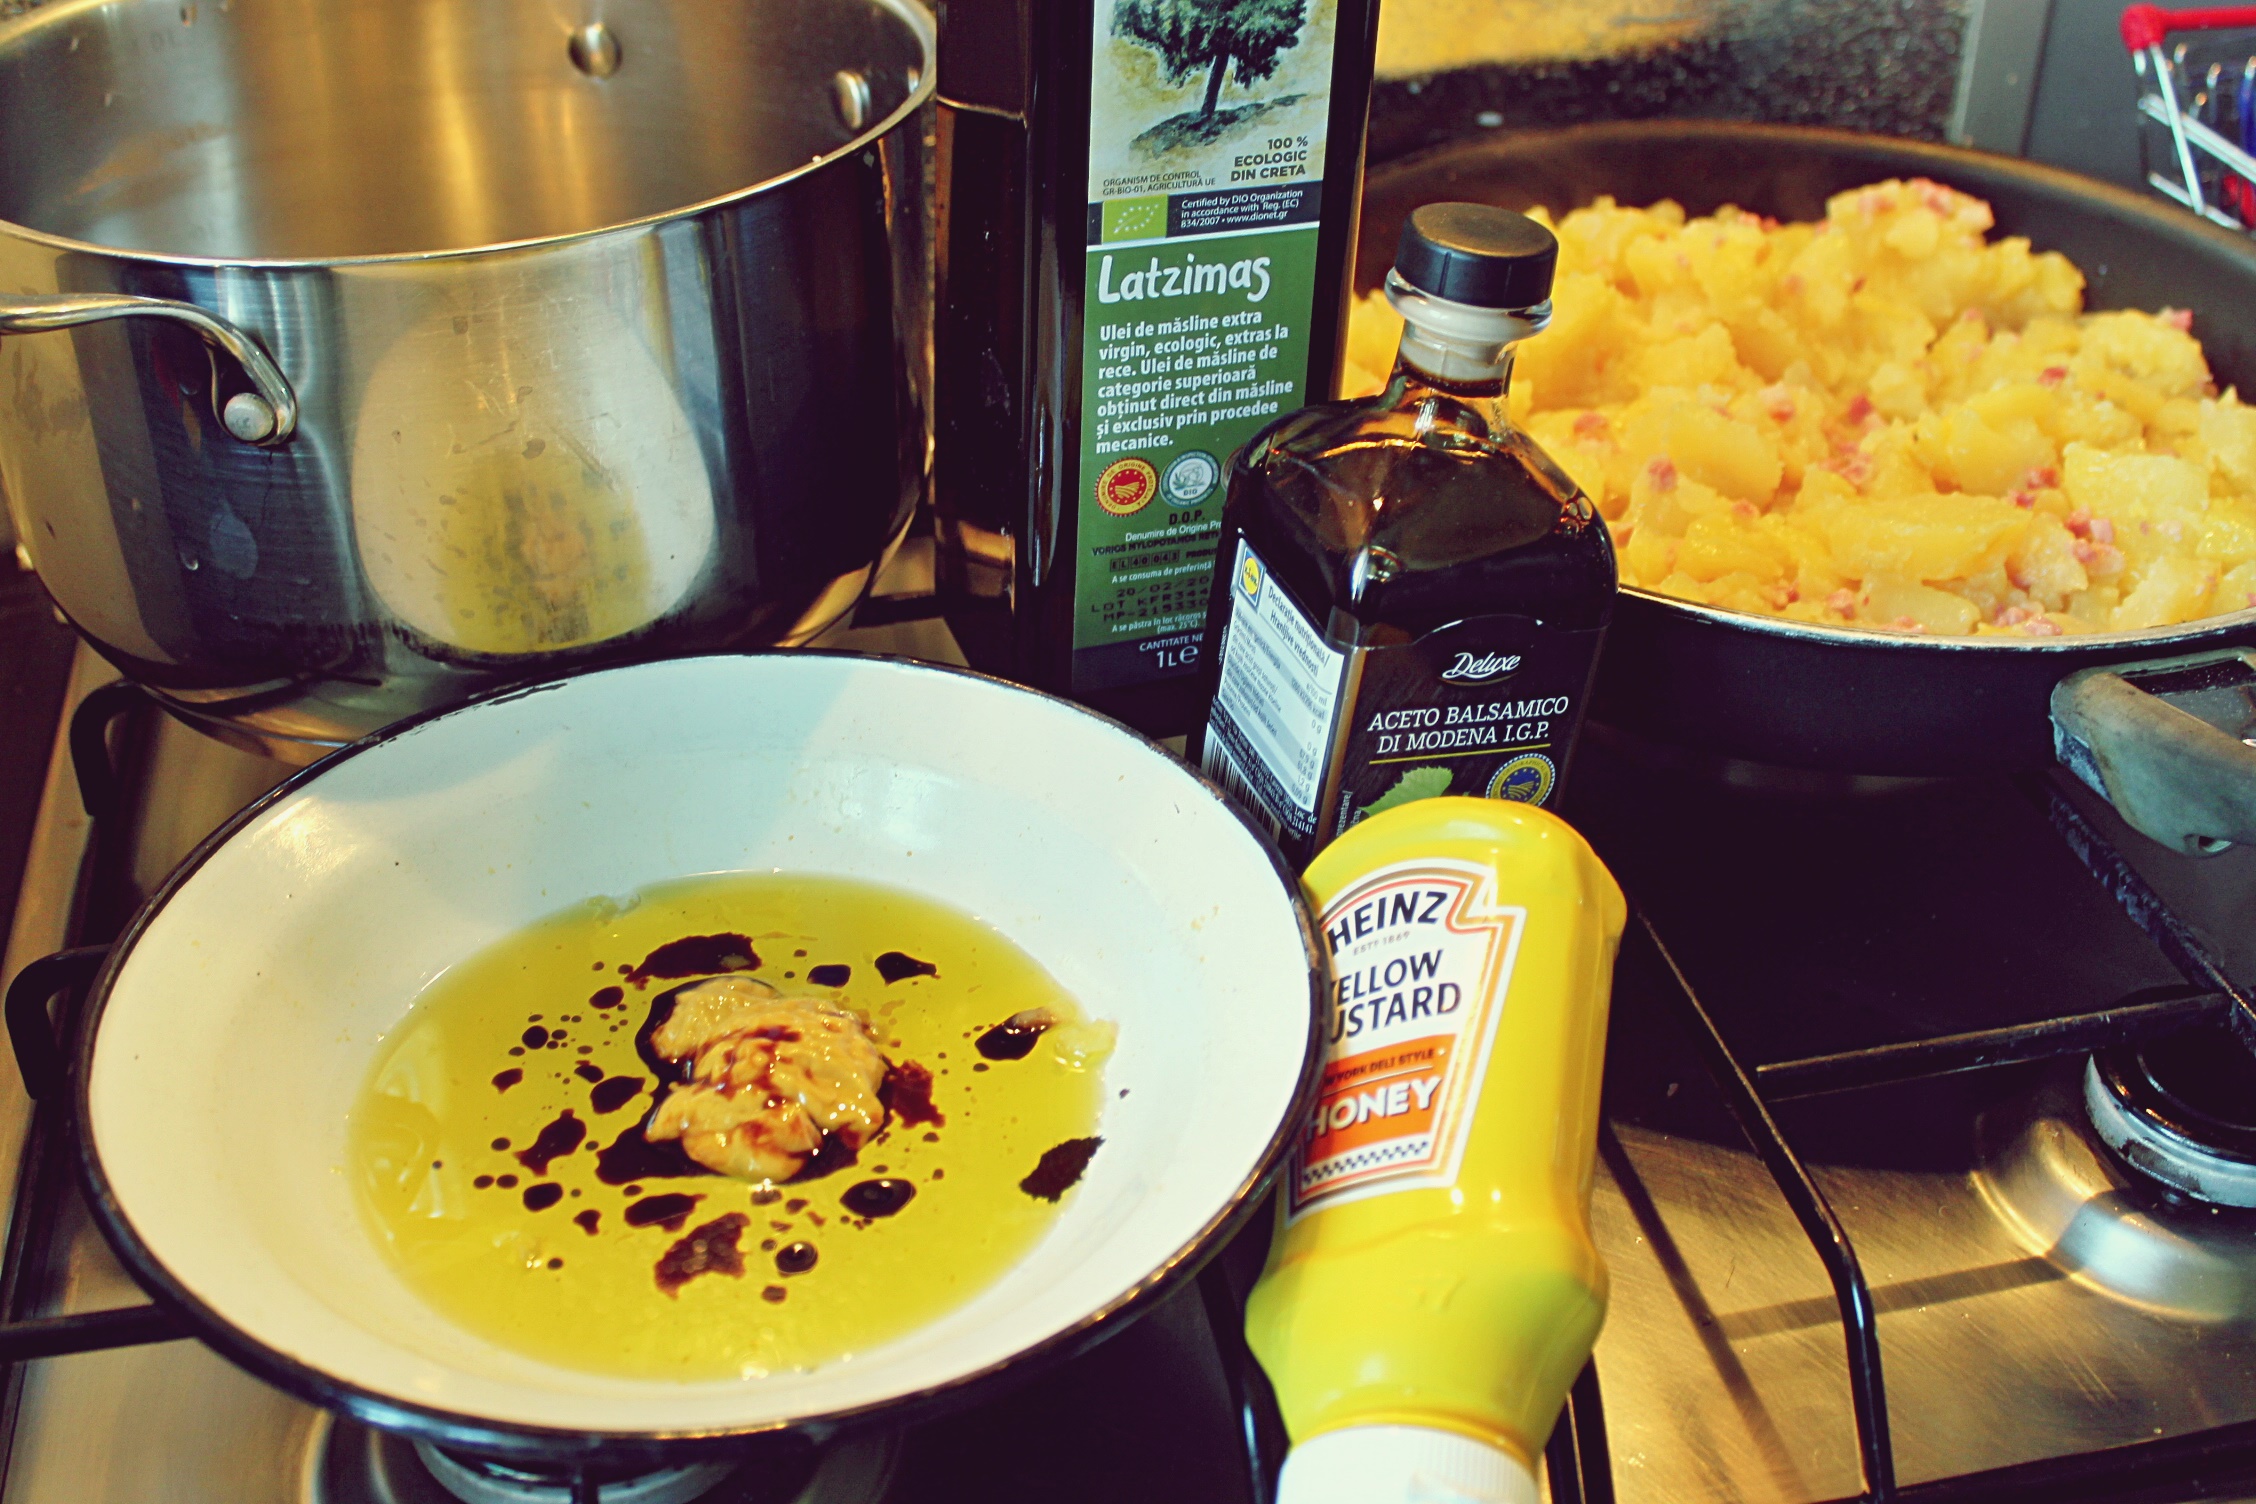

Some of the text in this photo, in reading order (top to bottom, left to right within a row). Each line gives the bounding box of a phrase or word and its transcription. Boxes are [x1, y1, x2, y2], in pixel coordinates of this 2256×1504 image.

[1268, 136, 1308, 150] 100 %
[1234, 150, 1307, 167] ECOLOGIC
[1104, 171, 1201, 187] ORGANISM DE CONTROL
[1205, 178, 1216, 186] UE
[1231, 164, 1306, 182] DIN CRETA
[1181, 190, 1303, 209] Certified by DIO Organization
[1181, 199, 1300, 218] in accordance with Reg. (EC)
[1181, 210, 1288, 228] 834/2007 www.dionet.gr
[1099, 253, 1271, 303] Latzimas
[1100, 311, 1262, 341] Ulei de măsline extra
[1099, 324, 1289, 363] virgin, ecologic, extras la
[1098, 344, 1278, 380] rece. Ulei de măsline de
[1098, 365, 1256, 400] categorie superioară
[1160, 390, 1205, 411] direct
[1208, 387, 1232, 404] din
[1235, 379, 1293, 400] măsline
[1112, 412, 1173, 434] exclusiv
[1176, 409, 1207, 430] prin
[1210, 400, 1278, 425] procedee
[1096, 435, 1174, 454] mecanice.
[1169, 510, 1206, 525] D.O.P.
[1125, 530, 1164, 542] Denumire
[1166, 527, 1177, 536] de
[1179, 523, 1208, 535] Origine
[1112, 575, 1118, 584] A
[1119, 574, 1128, 583] se
[1129, 569, 1162, 581] consuma
[1163, 566, 1173, 575] de
[1111, 624, 1118, 633] A
[1119, 624, 1128, 632] se
[1139, 635, 1190, 652] CANTITATE
[1442, 651, 1521, 680] Deluxe
[1367, 695, 1569, 732] ACETO BALSAMICO
[1376, 721, 1550, 755] DI MODENA I.G.P.
[1327, 890, 1448, 957] HEINZ
[1383, 930, 1410, 945] 1869
[1369, 1058, 1395, 1073] DELI
[1398, 1049, 1435, 1065] STYLE
[1306, 1076, 1442, 1139] HONEY
